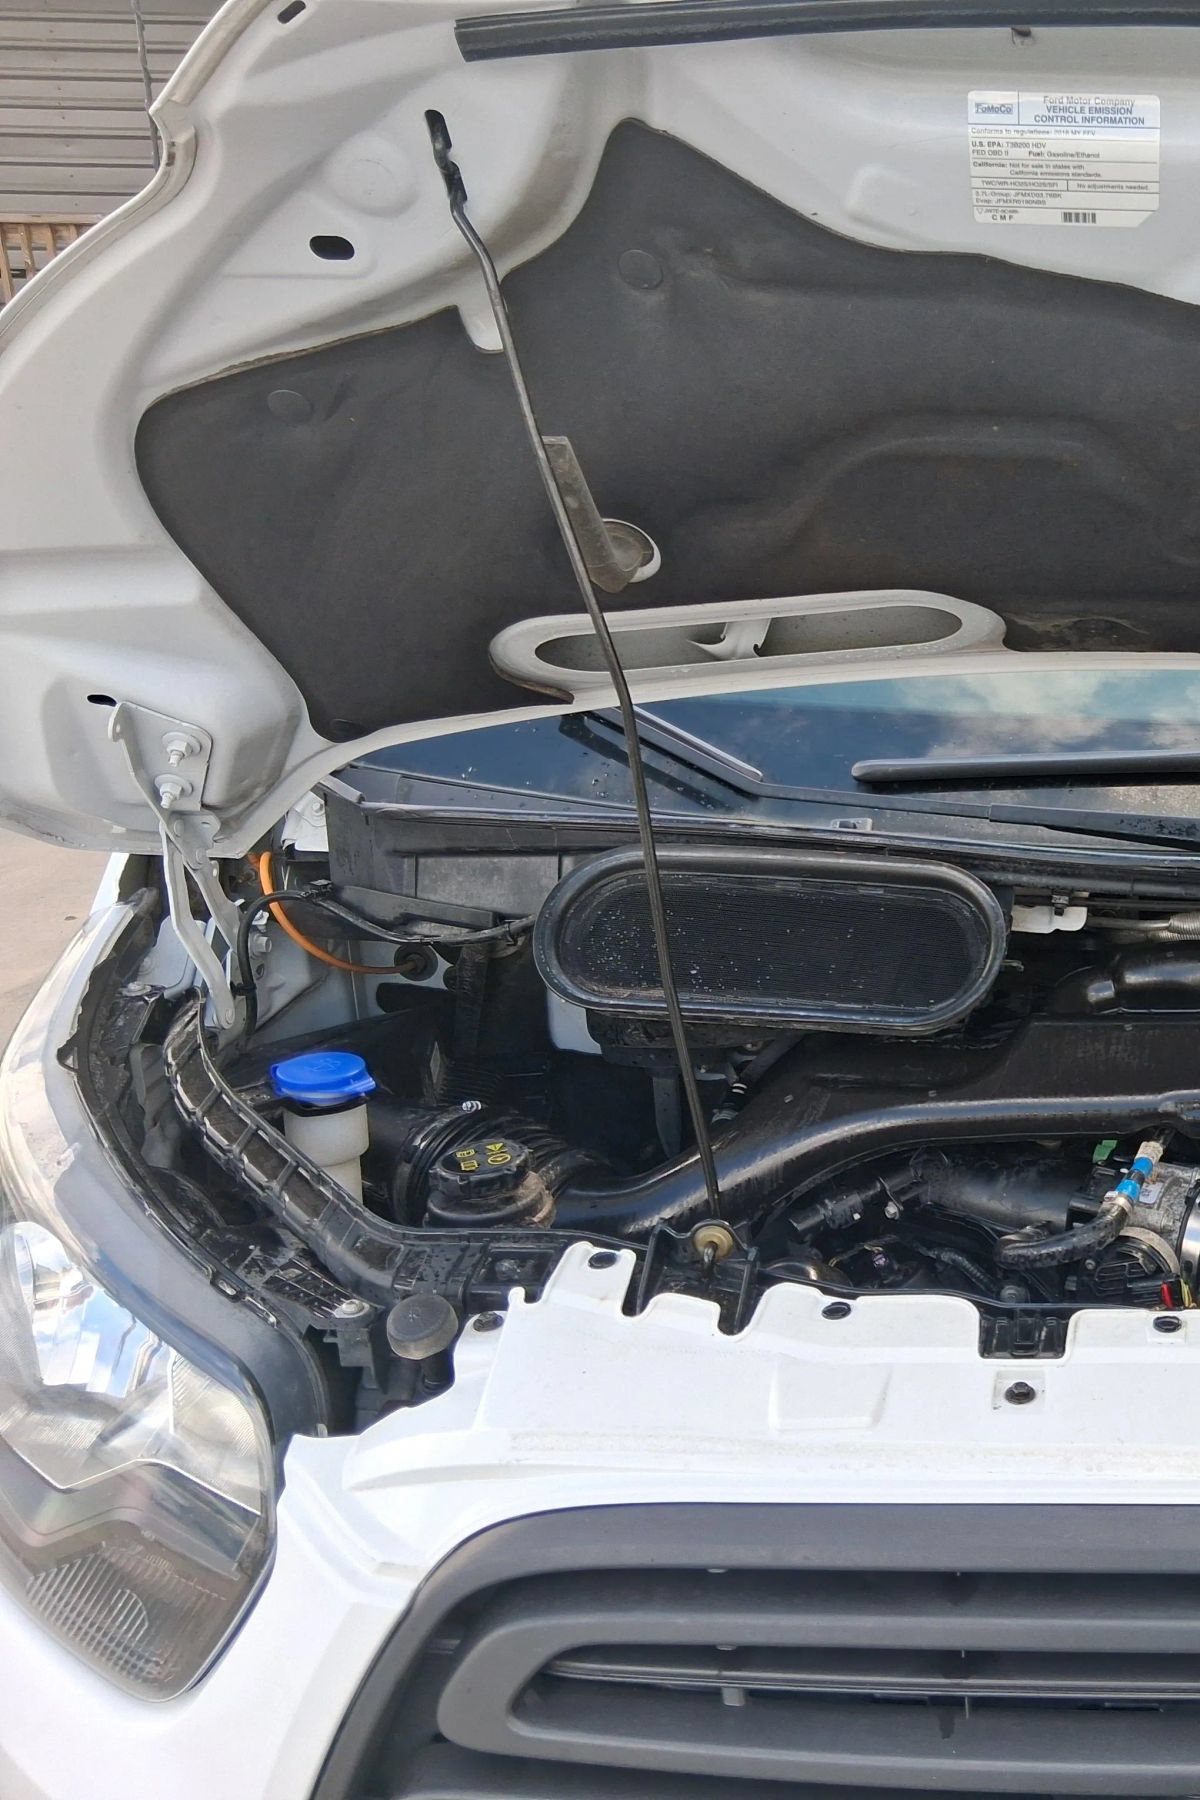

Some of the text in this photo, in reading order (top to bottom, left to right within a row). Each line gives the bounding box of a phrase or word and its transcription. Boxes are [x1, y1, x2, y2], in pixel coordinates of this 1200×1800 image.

[1043, 96, 1135, 107] Ford Motor Company
[976, 103, 1013, 114] FoMoCo
[1047, 105, 1132, 115] VEHICLE EMISSION
[1034, 114, 1144, 125] CONTROL INFORMATION
